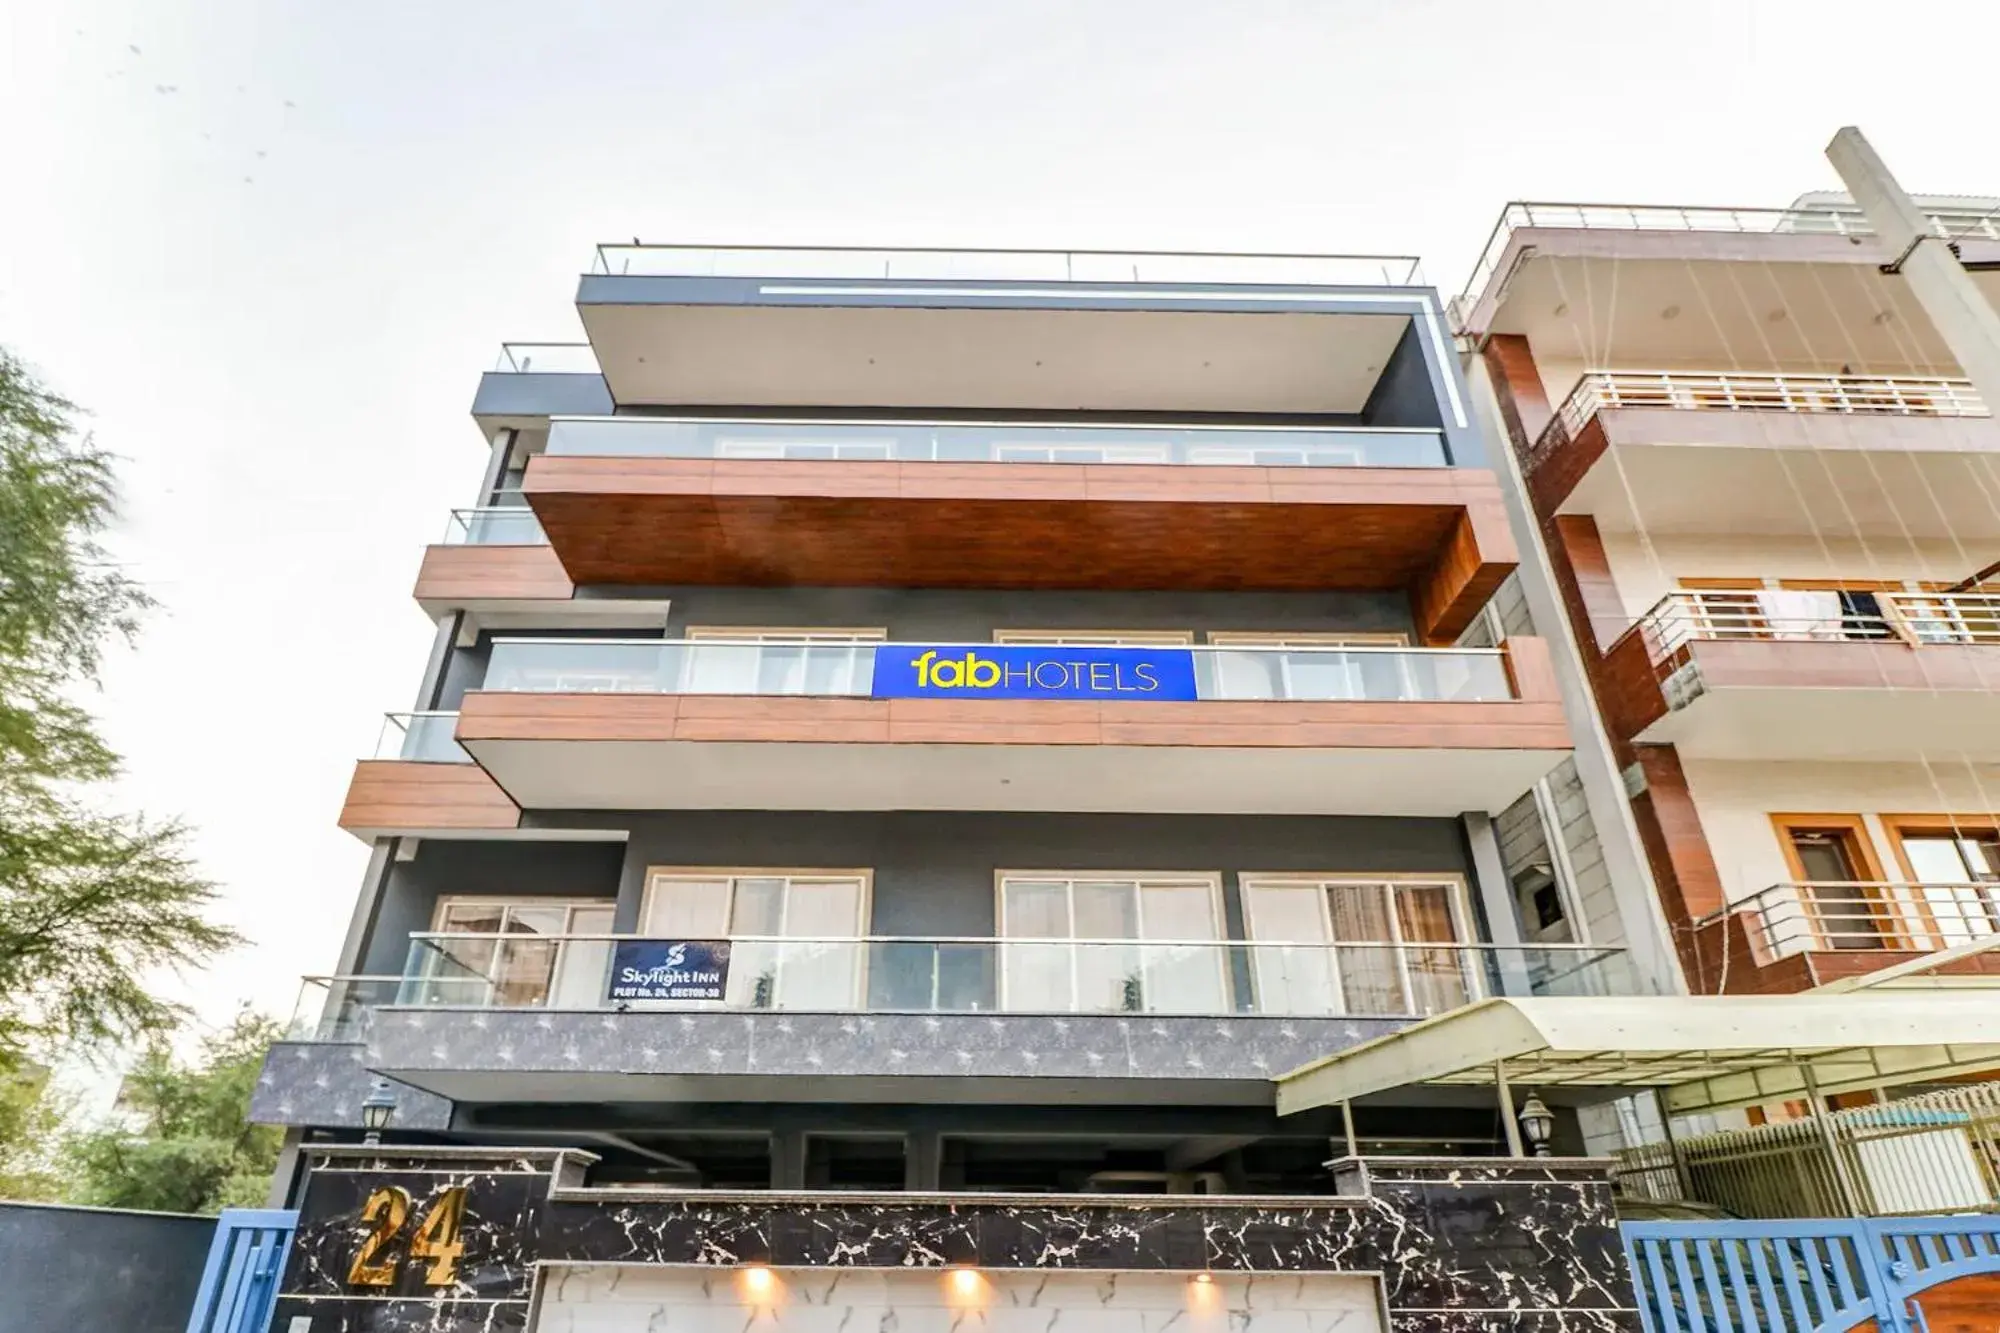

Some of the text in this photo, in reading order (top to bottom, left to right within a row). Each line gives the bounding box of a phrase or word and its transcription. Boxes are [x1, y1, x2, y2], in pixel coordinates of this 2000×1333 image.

[621, 967, 720, 987] Skylight INN
[614, 987, 637, 997] PLOT
[348, 1186, 467, 1286] 24
